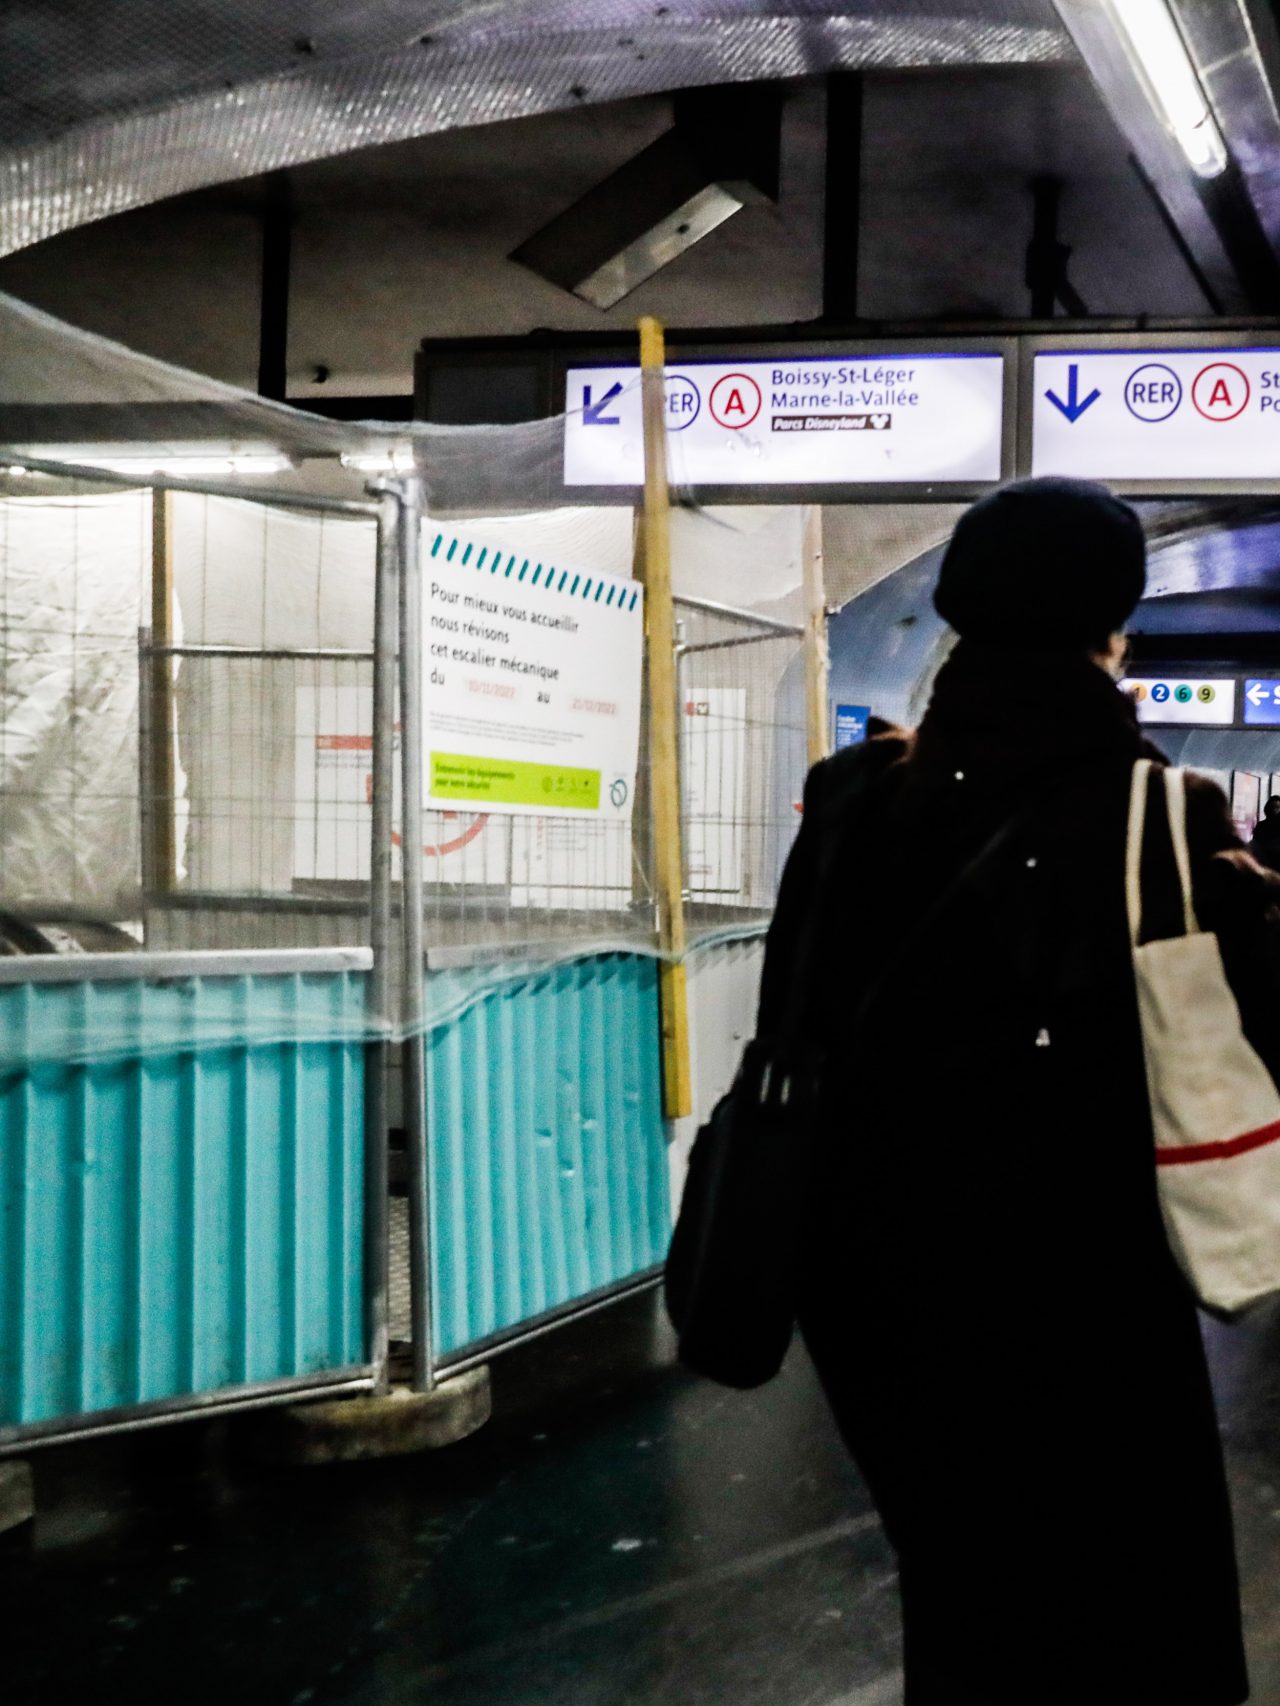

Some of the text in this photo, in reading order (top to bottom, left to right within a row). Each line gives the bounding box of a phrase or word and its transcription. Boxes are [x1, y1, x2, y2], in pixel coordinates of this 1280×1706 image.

[771, 367, 916, 388] Boissy-St-Léger
[664, 393, 693, 412] ER
[724, 388, 746, 415] A
[771, 389, 920, 408] Marne-la-Vallée
[1132, 384, 1174, 404] RER
[1208, 379, 1233, 407] A
[773, 415, 867, 430] Parcs Disneyland
[431, 582, 579, 632] Pour mieux vous accueillir
[431, 616, 509, 644] nous révisons
[431, 643, 560, 681] cet escalier mécanique
[430, 665, 445, 685] du
[537, 690, 550, 704] au
[1155, 686, 1165, 700] 2
[1178, 687, 1187, 699] 6
[1202, 687, 1211, 700] 9
